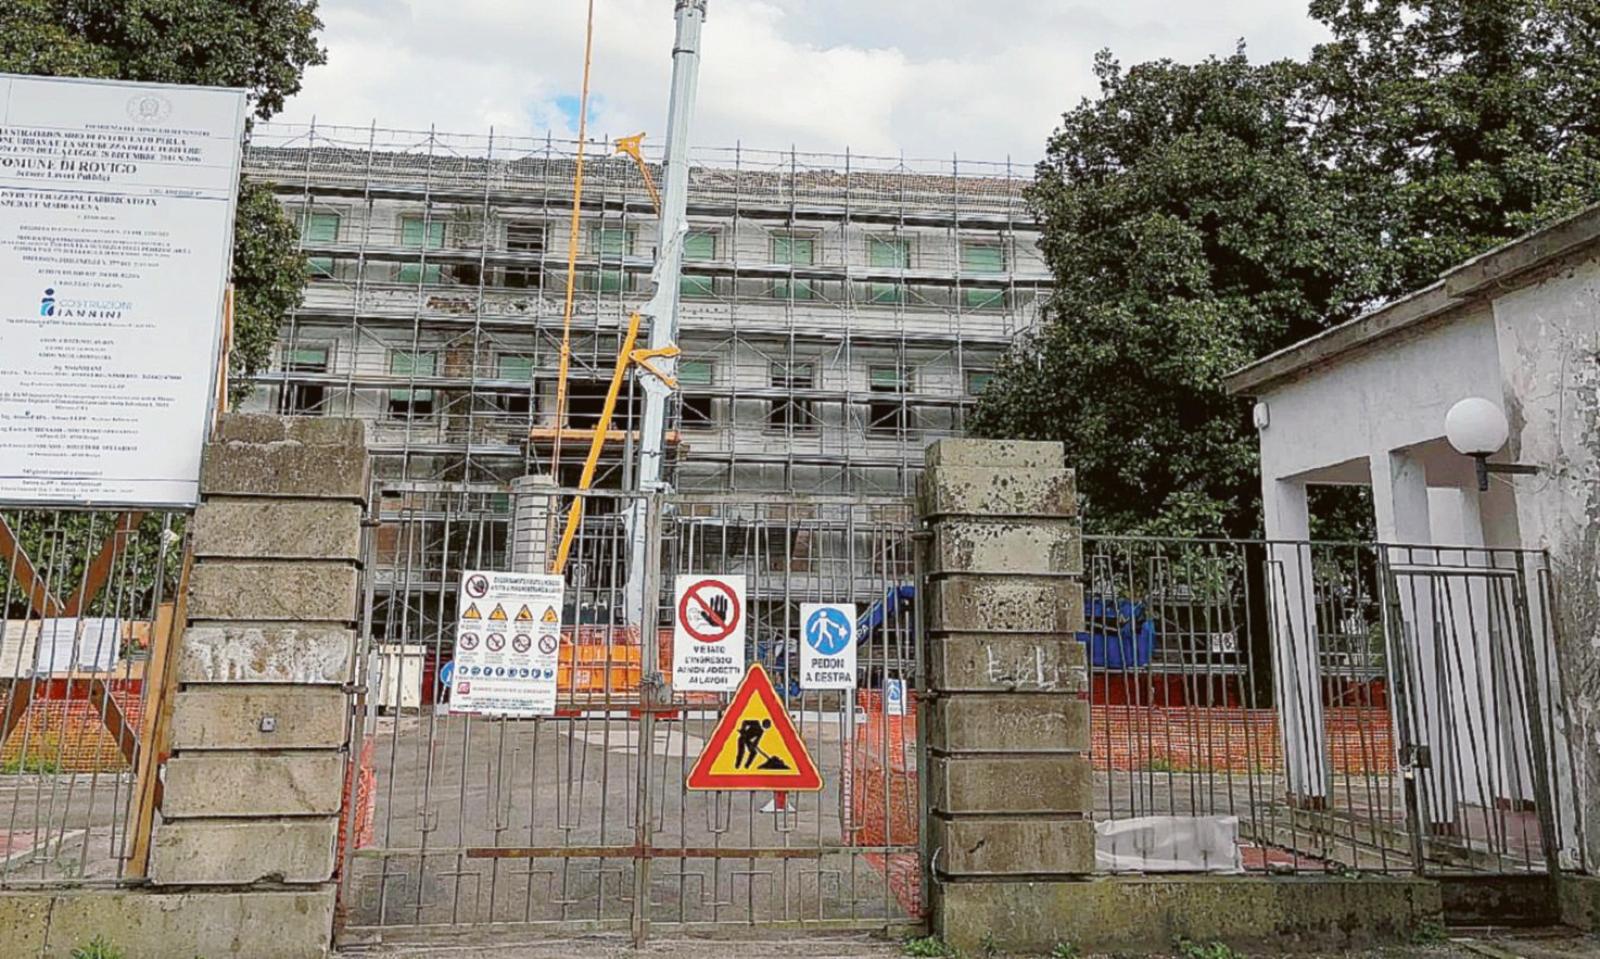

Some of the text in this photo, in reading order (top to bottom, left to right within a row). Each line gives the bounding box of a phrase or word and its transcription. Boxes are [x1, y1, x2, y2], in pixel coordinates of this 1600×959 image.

[0, 157, 137, 174] OMUNE DI ROVIGO
[59, 299, 132, 310] COSTRUZIONI
[57, 308, 122, 319] IANNINI
[685, 656, 733, 664] L'INGRESSO
[699, 676, 728, 685] LAVORI
[805, 672, 852, 682] A DESTRA
